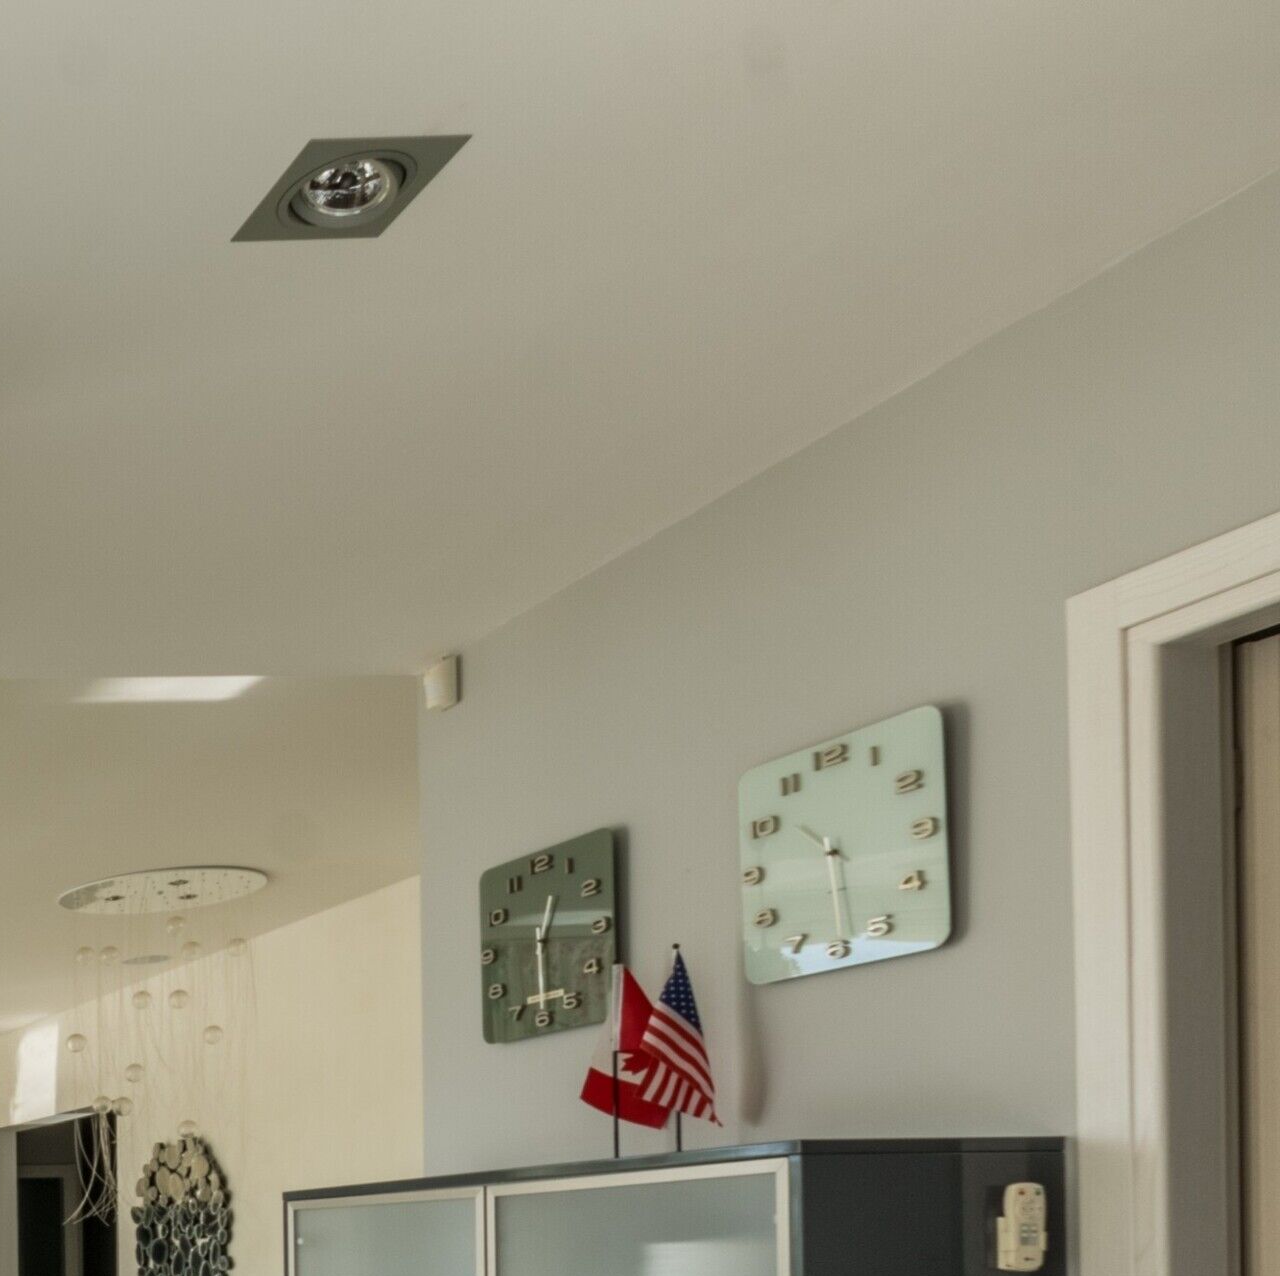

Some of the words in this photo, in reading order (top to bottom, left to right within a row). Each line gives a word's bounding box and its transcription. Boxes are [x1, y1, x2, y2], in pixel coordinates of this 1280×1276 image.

[814, 744, 848, 770] 12
[871, 747, 880, 765] 1
[781, 773, 801, 796] 11
[897, 770, 924, 793] 2
[752, 816, 780, 838] 10
[913, 817, 939, 838] 3
[531, 855, 553, 874] 12
[566, 858, 574, 873] 1
[508, 876, 523, 893] 11
[745, 867, 764, 885] 9
[900, 870, 927, 890] 4
[581, 879, 602, 896] 2
[592, 917, 611, 933] 3
[755, 908, 777, 927] 8
[868, 915, 893, 936] 5
[787, 934, 808, 954] 7
[828, 940, 850, 959] 6
[481, 950, 497, 964] 9
[584, 959, 602, 974] 4
[489, 984, 506, 998] 8
[564, 993, 581, 1008] 5
[509, 1005, 527, 1020] 7
[536, 1011, 553, 1026] 6
